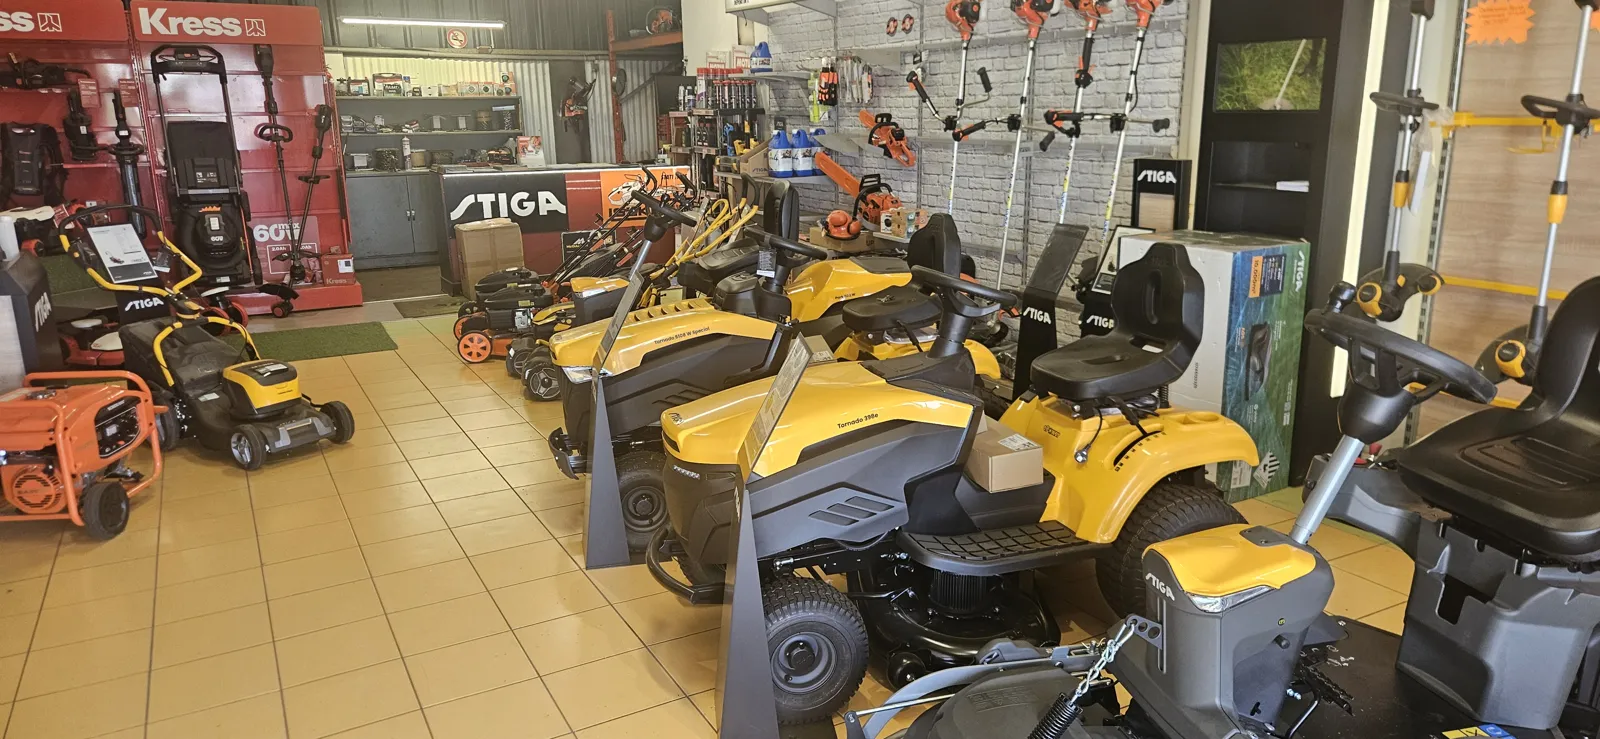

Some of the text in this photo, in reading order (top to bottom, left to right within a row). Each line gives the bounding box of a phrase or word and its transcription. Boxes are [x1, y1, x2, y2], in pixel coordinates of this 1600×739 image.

[138, 7, 242, 36] Kress
[1137, 169, 1177, 184] STIGA
[450, 191, 567, 221] STIGA
[1295, 250, 1306, 293] STIGA
[124, 297, 165, 312] STIGA
[1022, 306, 1052, 325] STIGA
[692, 326, 711, 335] Special
[837, 417, 864, 429] Tornado
[1145, 572, 1175, 602] STIGA
